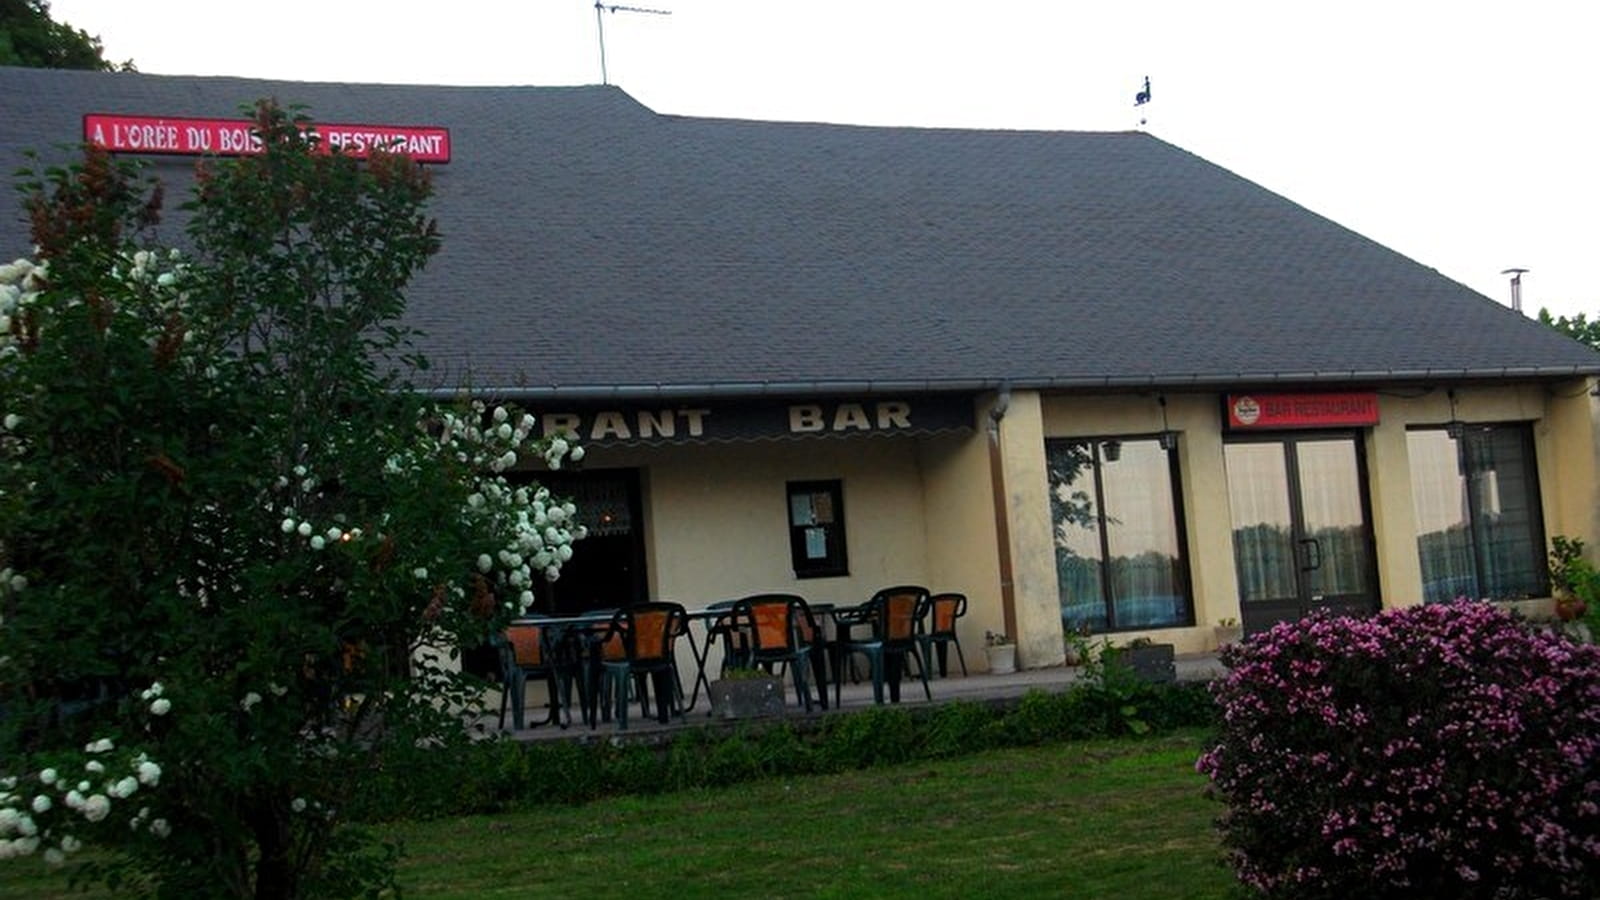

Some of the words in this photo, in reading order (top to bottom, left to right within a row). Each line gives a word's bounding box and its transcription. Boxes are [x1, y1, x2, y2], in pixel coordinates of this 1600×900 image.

[93, 124, 106, 146] A
[113, 119, 179, 150] L'ORÉE
[186, 127, 212, 151] DU
[219, 128, 263, 153] BOIS
[788, 401, 913, 433] BAR
[1266, 399, 1292, 417] BAR
[1295, 396, 1375, 415] RESTAURANT
